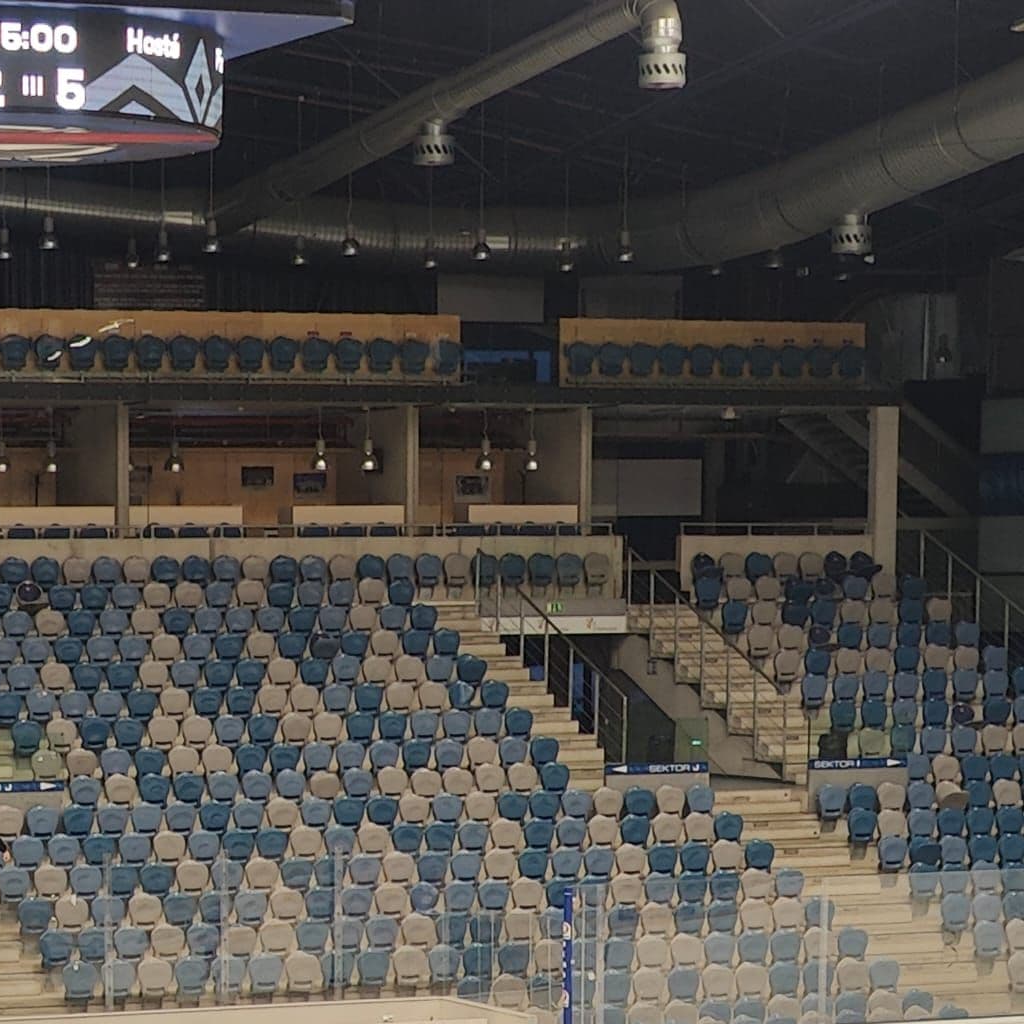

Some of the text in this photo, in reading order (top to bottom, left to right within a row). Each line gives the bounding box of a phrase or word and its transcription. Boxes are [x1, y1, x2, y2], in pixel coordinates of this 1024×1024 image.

[56, 67, 86, 111] 5
[814, 759, 855, 768] SEKTOR
[649, 764, 690, 773] SEKTOR
[4, 783, 12, 791] J
